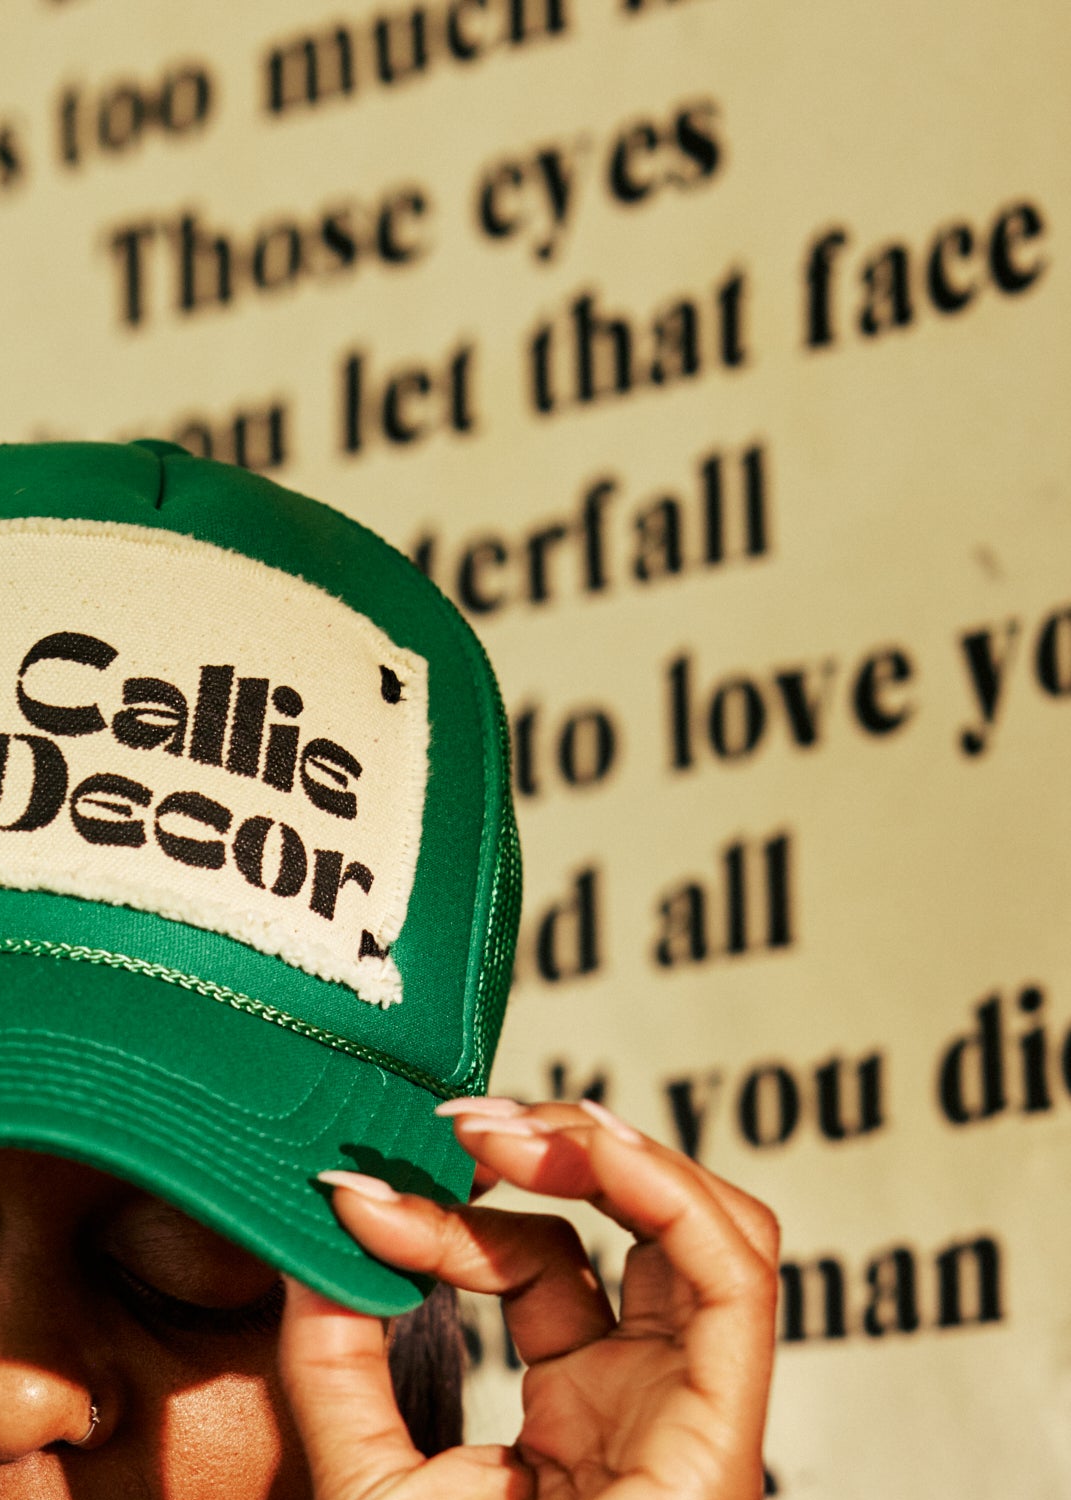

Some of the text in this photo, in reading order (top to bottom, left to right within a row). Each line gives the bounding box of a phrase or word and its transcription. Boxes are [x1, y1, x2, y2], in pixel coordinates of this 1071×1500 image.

[57, 65, 216, 169] too
[108, 101, 725, 331] Those eyes
[339, 344, 477, 459] let
[526, 267, 749, 418] that
[802, 200, 1047, 354] face
[16, 630, 364, 821] Callie
[515, 703, 620, 801] to
[665, 646, 916, 775] love
[651, 829, 797, 971] all
[664, 982, 1071, 1160] you di
